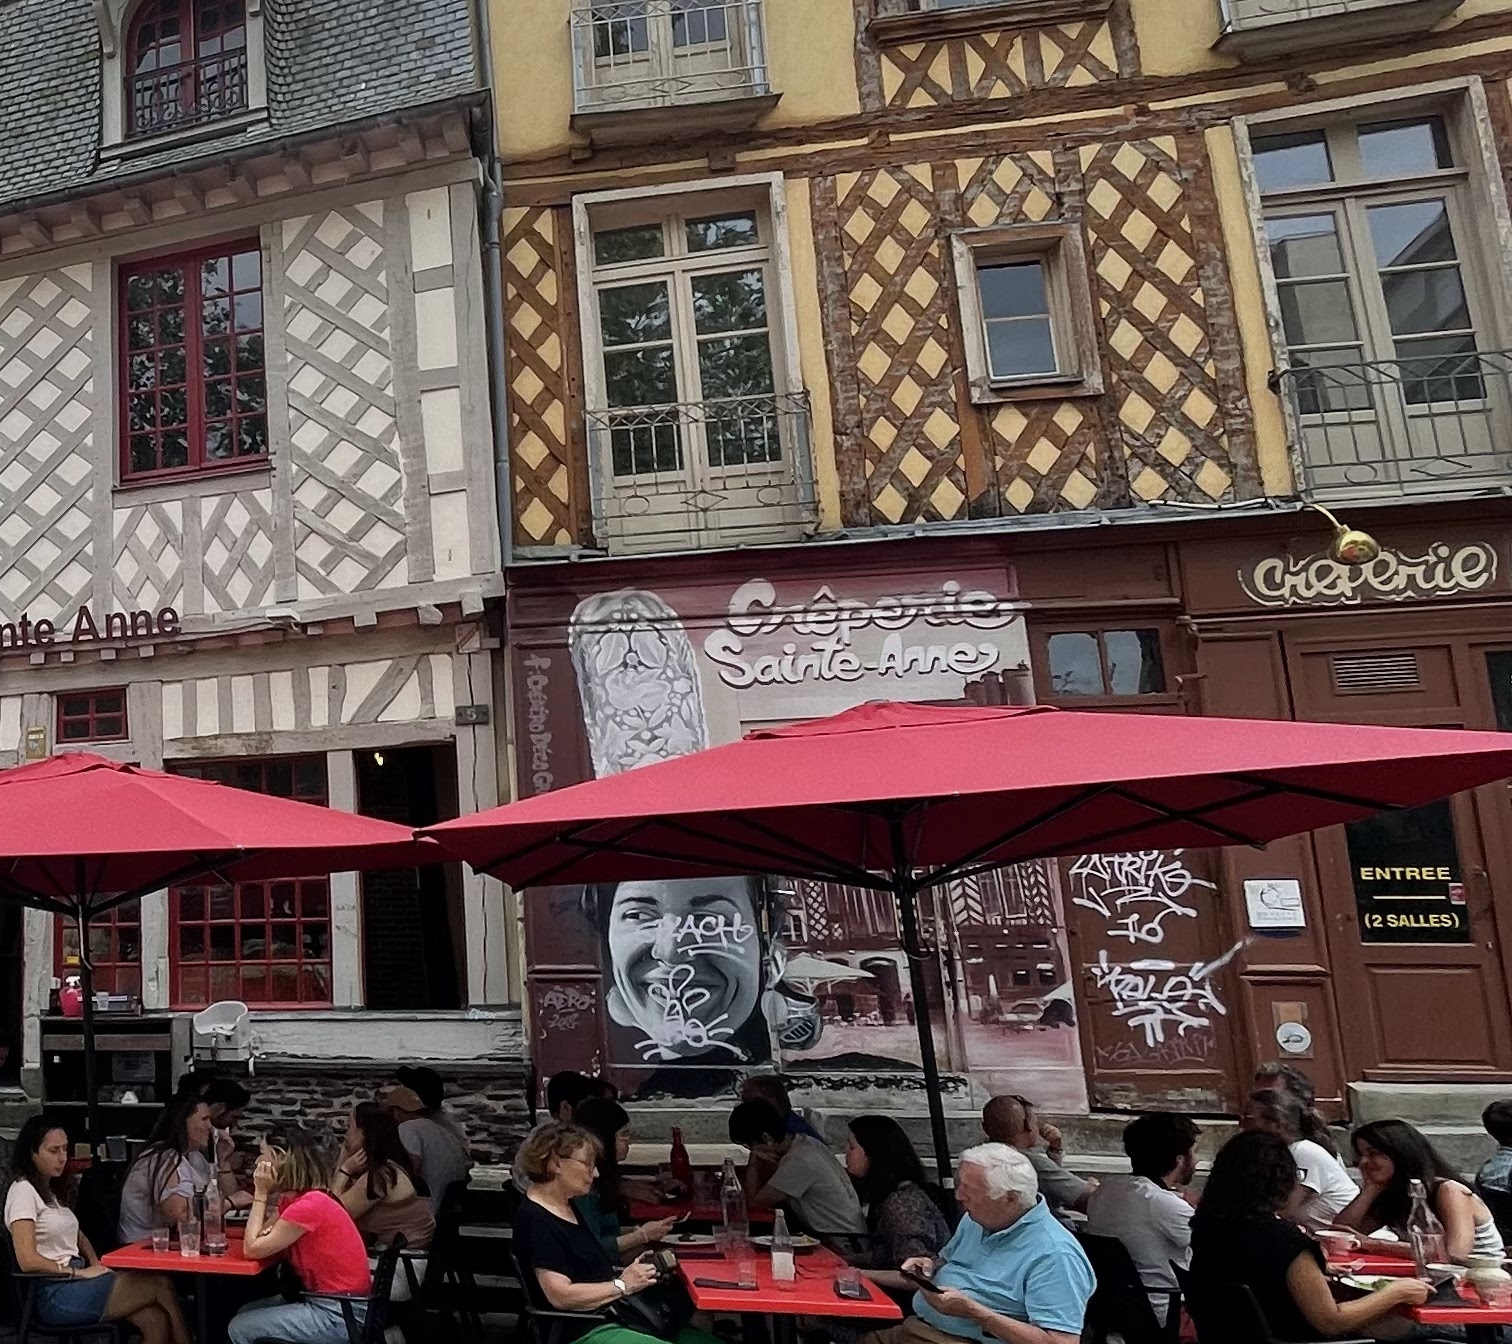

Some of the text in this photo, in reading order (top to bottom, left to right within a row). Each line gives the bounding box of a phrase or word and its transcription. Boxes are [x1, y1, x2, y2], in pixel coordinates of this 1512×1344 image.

[72, 605, 182, 645] Anne
[467, 708, 477, 721] 5
[1360, 866, 1452, 881] ENTREE
[1364, 912, 1460, 929] (2 SALLES)
